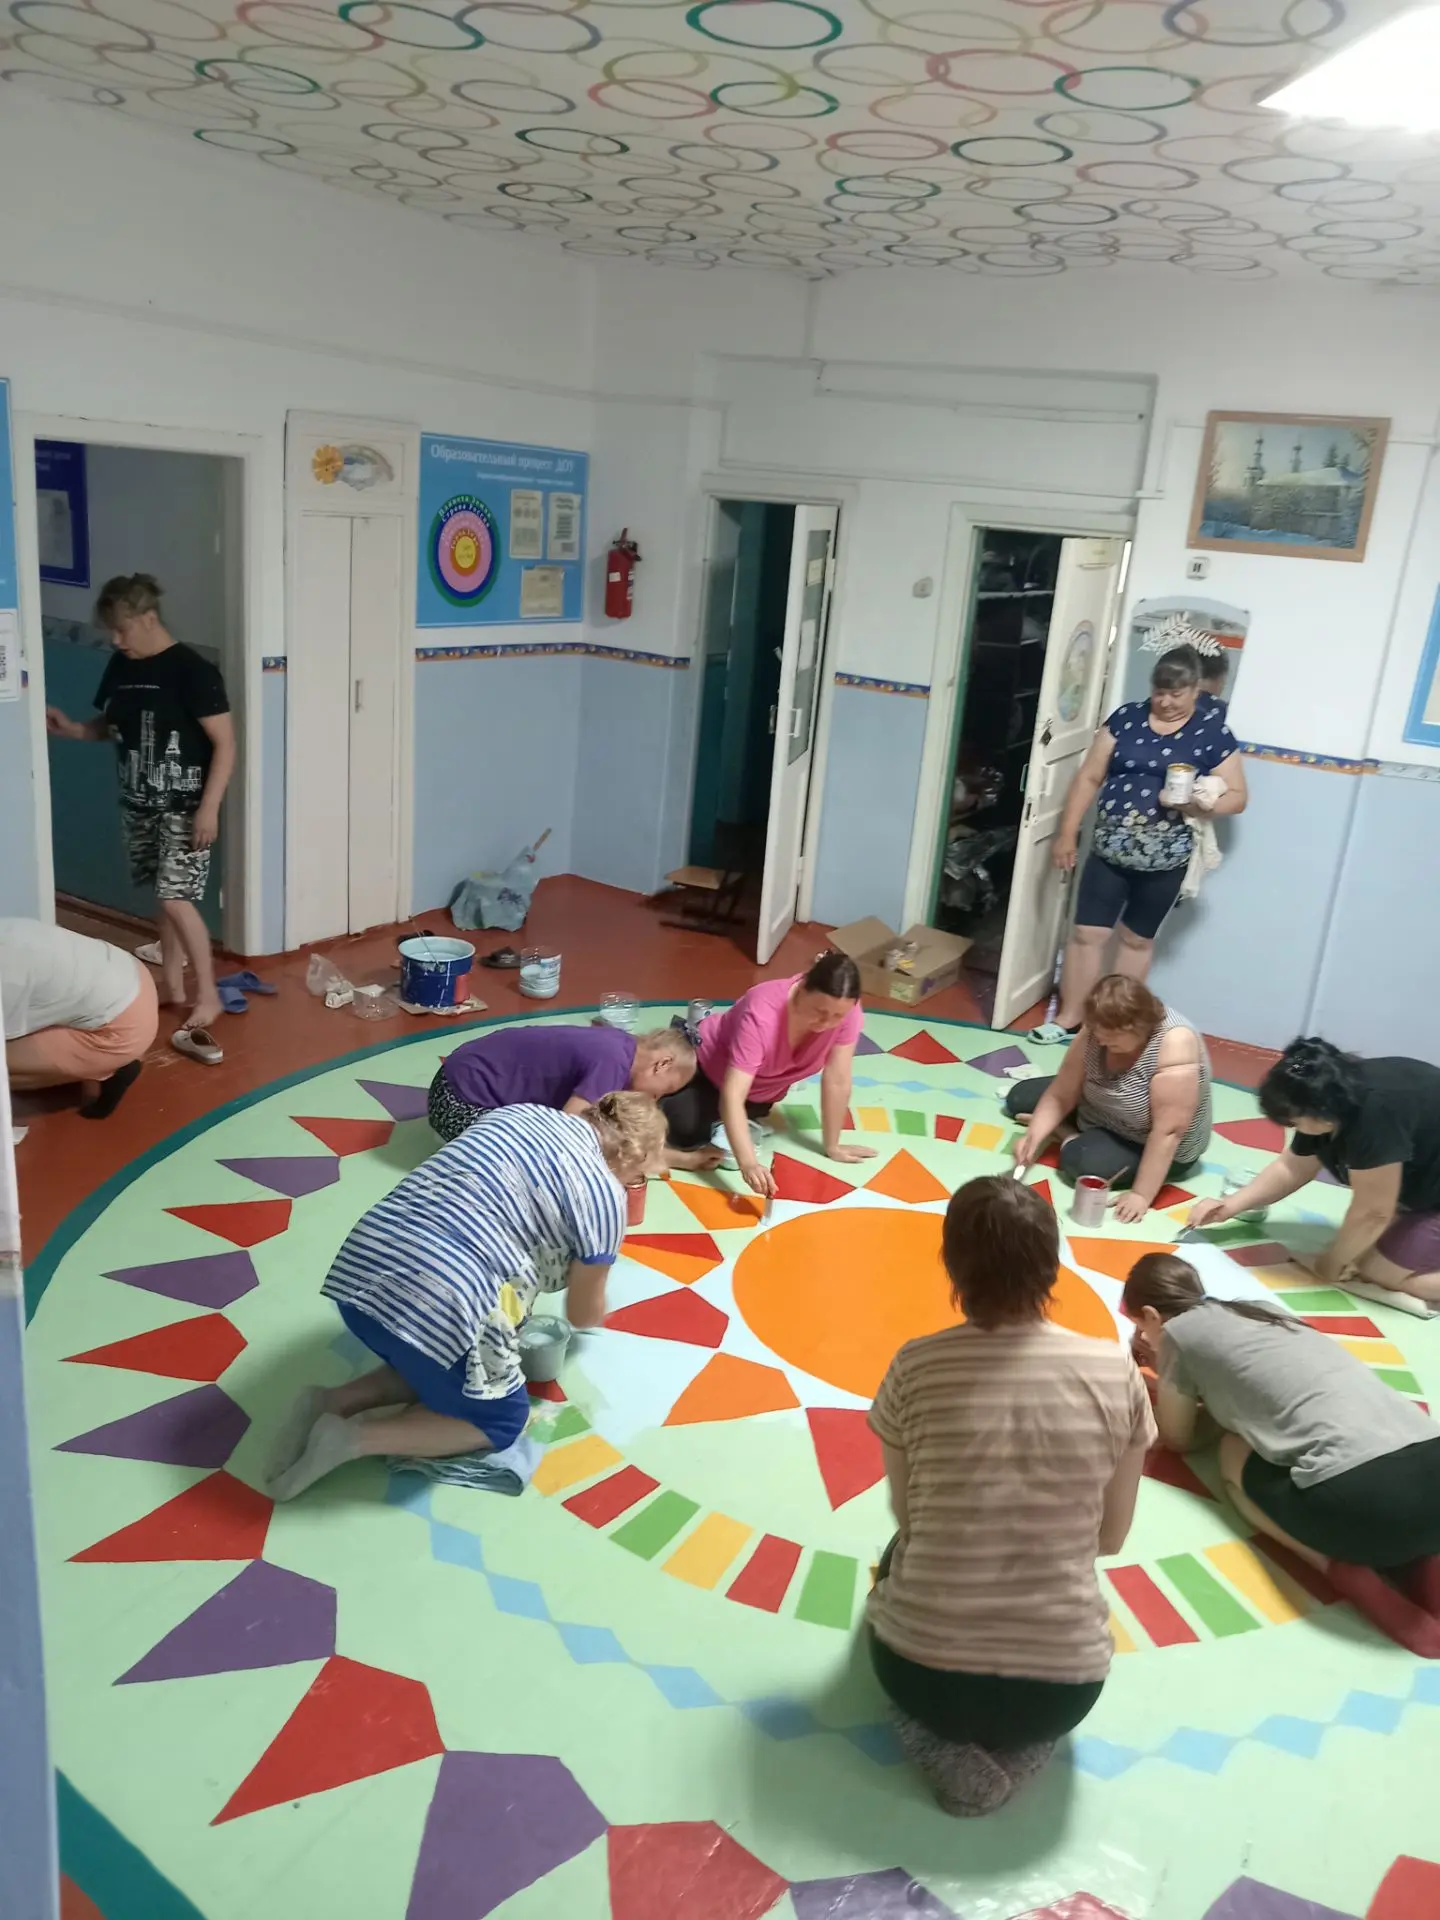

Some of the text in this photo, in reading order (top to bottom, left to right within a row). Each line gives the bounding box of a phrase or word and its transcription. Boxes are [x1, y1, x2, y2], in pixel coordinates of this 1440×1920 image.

[431, 444, 575, 473] Образовательный процесс ДОУ
[439, 496, 491, 519] Планета Земля
[442, 503, 490, 528] Страна Россия
